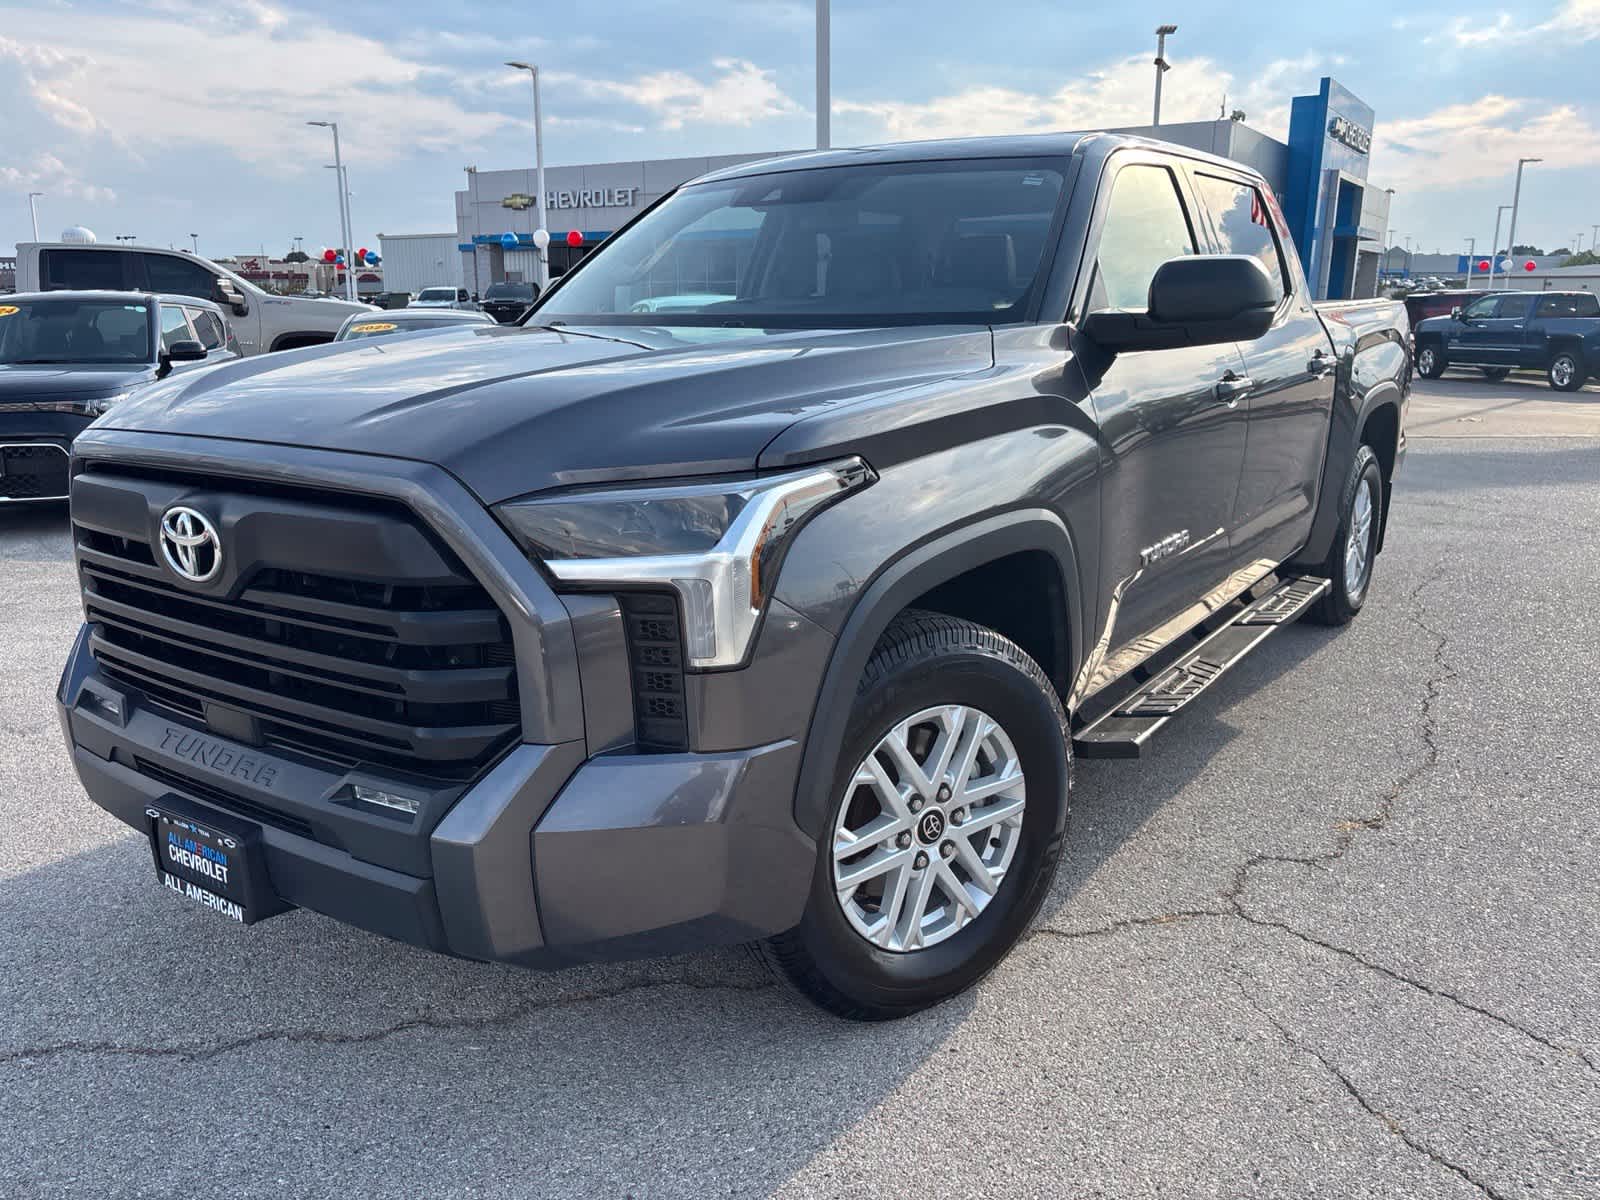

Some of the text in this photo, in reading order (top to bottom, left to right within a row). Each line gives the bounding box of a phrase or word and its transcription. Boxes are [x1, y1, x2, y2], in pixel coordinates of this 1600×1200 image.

[543, 187, 638, 209] HEVROLET
[160, 727, 278, 788] TUNDRA
[168, 831, 228, 866] ALL AMERICAN
[168, 844, 228, 884] CHEVROLET
[165, 873, 243, 922] ALL AMERICAN
